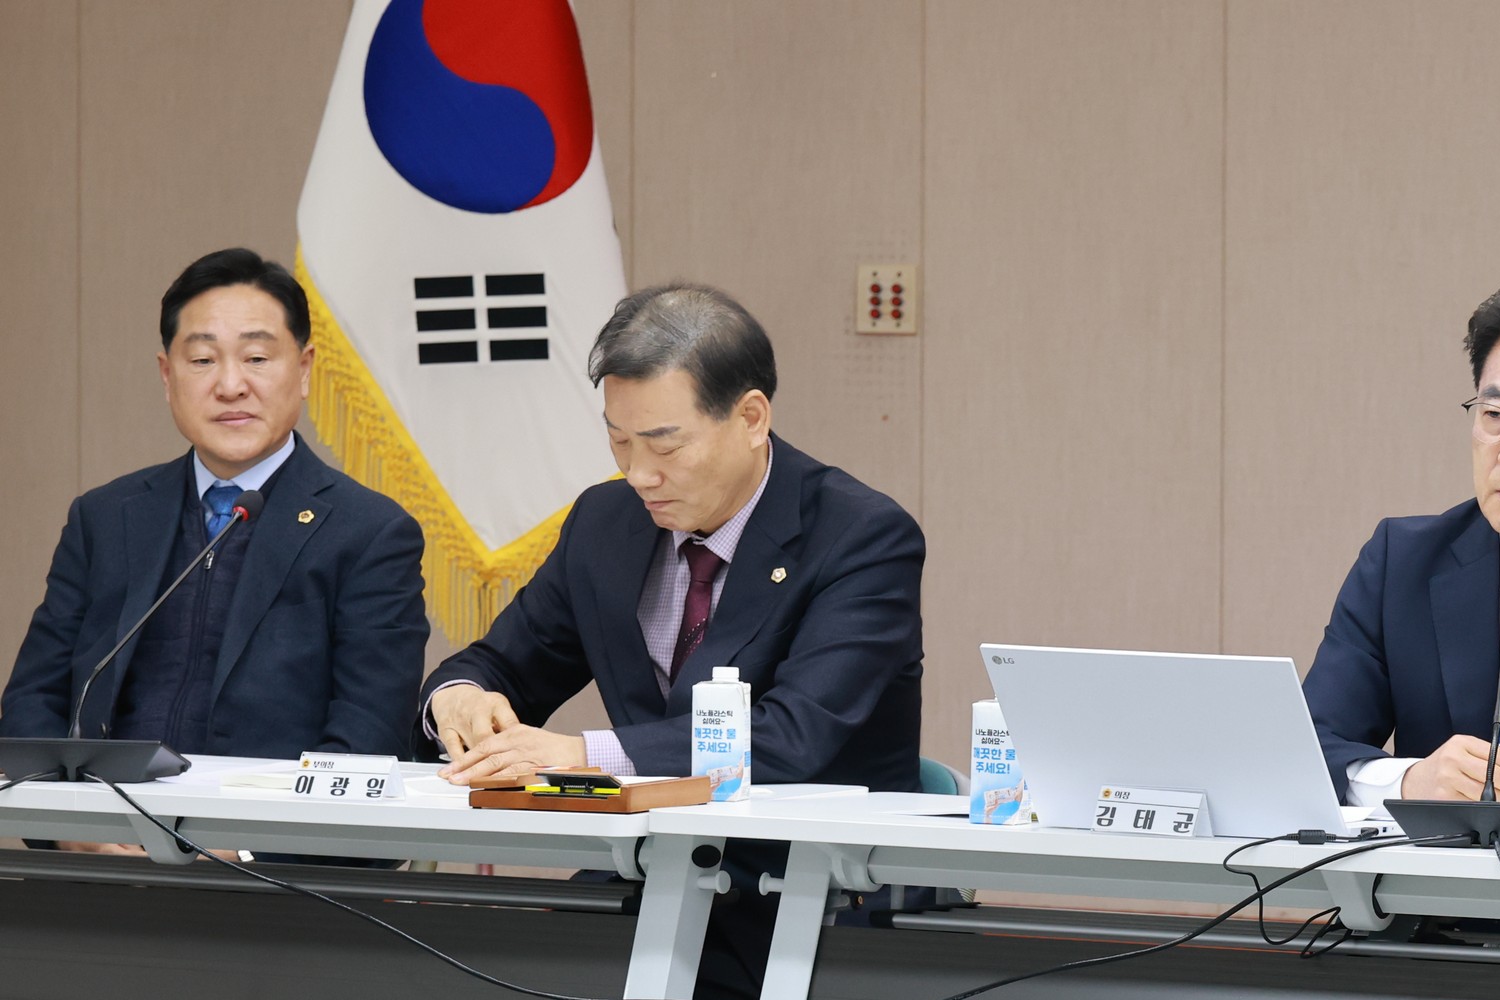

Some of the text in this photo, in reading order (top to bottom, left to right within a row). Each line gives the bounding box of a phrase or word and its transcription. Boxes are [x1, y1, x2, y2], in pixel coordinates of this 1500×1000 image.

[1002, 657, 1015, 665] LG
[696, 709, 734, 717] 나노플라스틱
[694, 727, 736, 740] 깨끗한 물
[697, 741, 732, 753] 주세요!
[973, 747, 1016, 761] 깨끗한 물
[976, 761, 1010, 774] 주세요!
[1114, 790, 1131, 800] 의장
